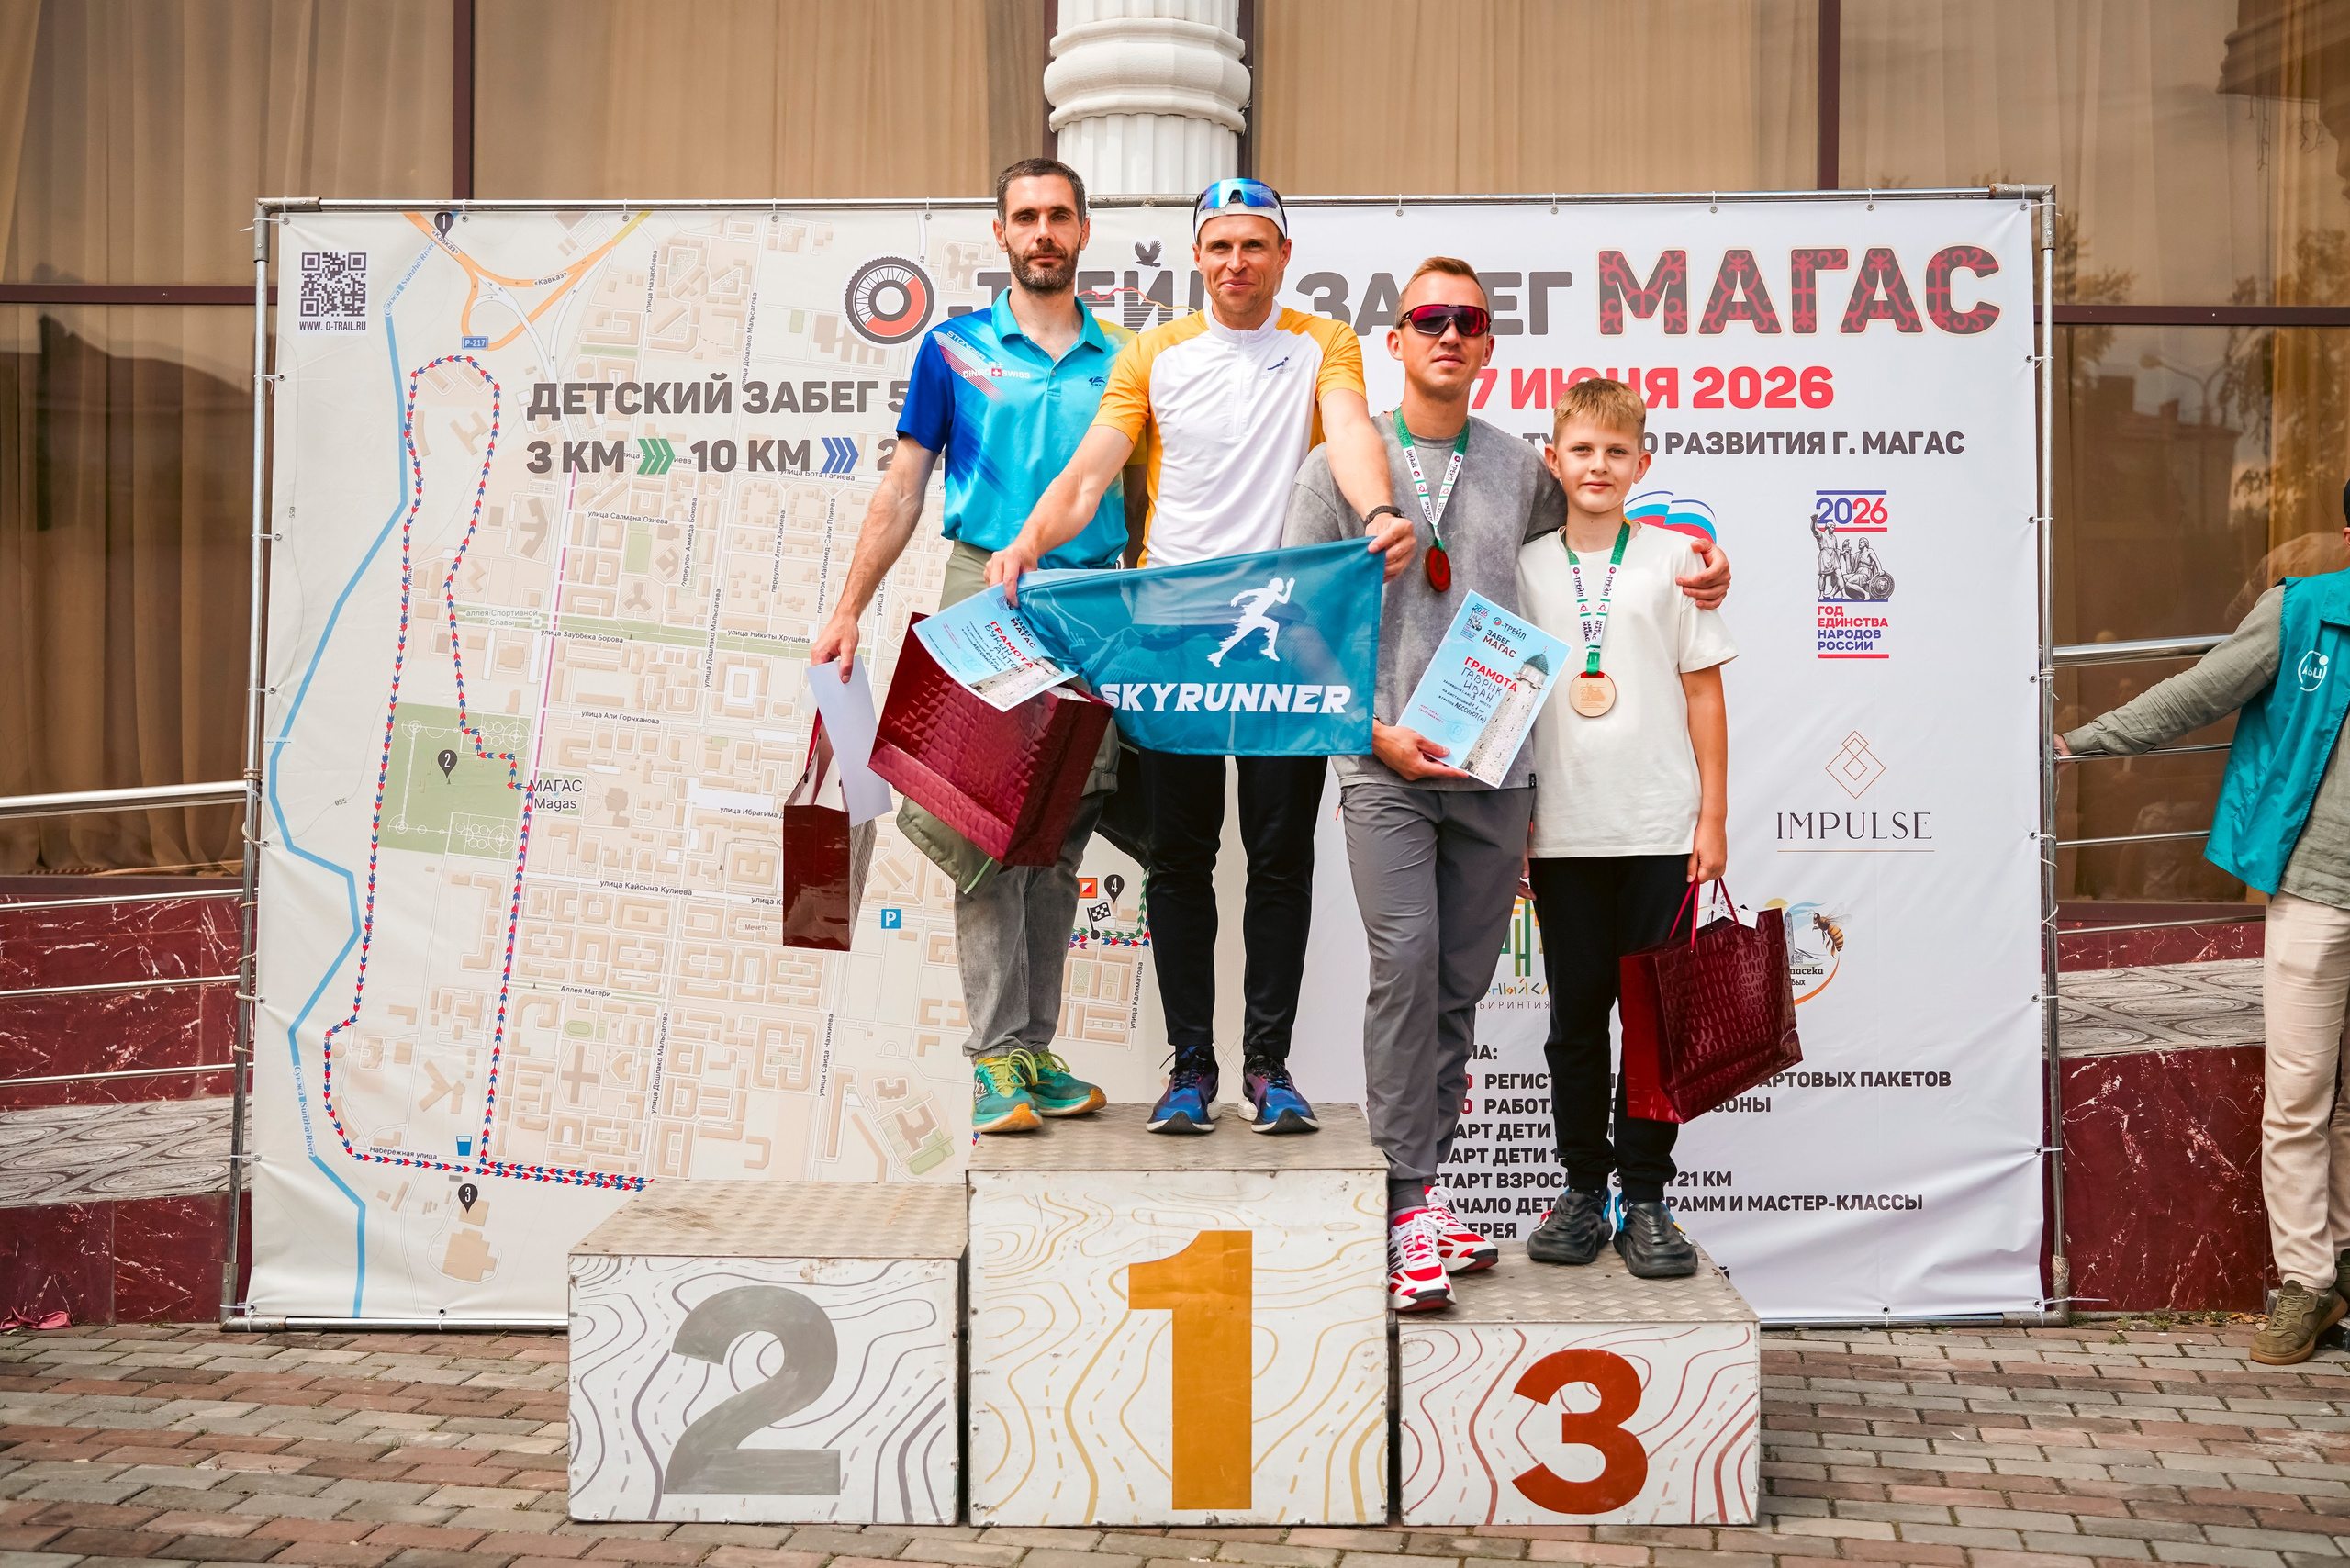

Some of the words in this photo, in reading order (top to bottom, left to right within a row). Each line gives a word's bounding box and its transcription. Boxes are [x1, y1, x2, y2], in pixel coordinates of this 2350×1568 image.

[420, 241, 434, 262] River
[534, 272, 567, 286] «Кавказ»
[647, 250, 658, 291] Назарбаева
[1598, 245, 2001, 335] МАГАС
[747, 292, 757, 333] Мальсагова
[1295, 272, 1572, 336] ЗАЕГ
[299, 321, 323, 331] WWW.
[743, 335, 752, 366] Дошлако
[946, 330, 987, 361] STONGER
[1002, 370, 1031, 378] SWISS
[526, 373, 732, 421] ДЕТСКИЙ
[742, 380, 878, 414] ЗАБЕГ
[1692, 366, 1834, 409] 2026
[1665, 431, 1826, 456] РАЗВИТИЯ
[1832, 432, 1855, 455] Г.
[1862, 431, 1965, 455] МАГАС
[526, 441, 551, 473] 3
[562, 441, 624, 473] КМ
[690, 439, 737, 473] 10
[748, 439, 811, 473] КМ
[610, 512, 642, 521] Салмана
[643, 516, 668, 524] Озиева
[688, 498, 698, 523] Бокова
[827, 498, 836, 525] Плиева
[1816, 498, 1888, 524] 2026
[685, 524, 694, 552] Ахмеда
[771, 560, 780, 593] переулок
[777, 510, 786, 539] Хакиева
[821, 526, 833, 579] Магомед-Сали
[681, 554, 690, 587] переулок
[817, 581, 826, 614] переулок
[877, 593, 885, 617] улица
[491, 610, 538, 618] Спортивной
[1818, 606, 1844, 617] ГОД
[705, 632, 716, 664] Дошлако
[711, 588, 722, 632] Мальсагова
[1010, 618, 1036, 649] МАГАС
[1014, 615, 1034, 638] ЗАБЕГ
[1818, 618, 1888, 629] ЕДИНСТВА
[564, 632, 596, 641] Заурбека
[598, 634, 624, 644] Борова
[750, 632, 778, 640] Никиты
[778, 634, 811, 644] Хрущёва
[990, 621, 1034, 668] ГРАМОТА
[1483, 635, 1516, 658] МАГАС
[1487, 629, 1511, 644] ЗАБЕГ
[1818, 630, 1882, 641] НАРОДОВ
[1818, 641, 1874, 651] РОССИИ
[1461, 667, 1503, 696] ГАВРИК
[1464, 656, 1518, 692] ГРАМОТА
[1101, 682, 1352, 714] SKYRUNNER
[1463, 680, 1494, 702] ИВАН
[581, 711, 602, 719] улица
[619, 714, 660, 724] Горчханова
[444, 754, 451, 768] 2
[530, 779, 583, 792] МАГАС
[534, 798, 576, 812] Magas
[720, 806, 741, 814] улица
[743, 809, 778, 819] Ибрагима
[1777, 812, 1932, 840] IMPULSE
[599, 879, 622, 889] улица
[625, 881, 658, 892] Кайсына
[660, 886, 693, 896] Кулиева
[1111, 878, 1118, 892] 4
[751, 897, 774, 905] улица
[561, 985, 582, 993] Аллея
[584, 988, 611, 997] Матери
[1132, 961, 1144, 1006] Калиматова
[1479, 1001, 1550, 1009] БИРИНТИЯ
[1130, 1007, 1138, 1029] улица
[657, 1012, 668, 1056] Мальсагова
[824, 1014, 834, 1048] Чахкиева
[821, 1050, 830, 1073] Саида
[653, 1058, 663, 1091] Дошлако
[1484, 1073, 1551, 1089] РЕГИС
[1758, 1071, 1856, 1088] РТОВЫХ
[1860, 1071, 1952, 1088] ПАКЕТОВ
[819, 1075, 827, 1097] улица
[1484, 1098, 1553, 1114] РАБОТ
[1453, 1124, 1493, 1139] АРТ
[1496, 1124, 1550, 1142] ДЕТИ
[306, 1135, 314, 1155] River
[369, 1146, 415, 1157] Набережная
[1444, 1148, 1489, 1164] АРТ
[1493, 1148, 1547, 1167] ДЕТИ
[1677, 1170, 1698, 1187] 21
[1703, 1170, 1732, 1187] КМ
[464, 1186, 471, 1203] 3
[1447, 1197, 1512, 1214] АЧАЛО
[1729, 1195, 1743, 1212] И
[1748, 1193, 1923, 1212] МАСТЕР-КЛАССЫ
[1471, 1223, 1517, 1238] ЕРЕЯ
[1128, 1228, 1252, 1511] 1
[664, 1286, 840, 1495] 2
[1513, 1349, 1649, 1515] 3
